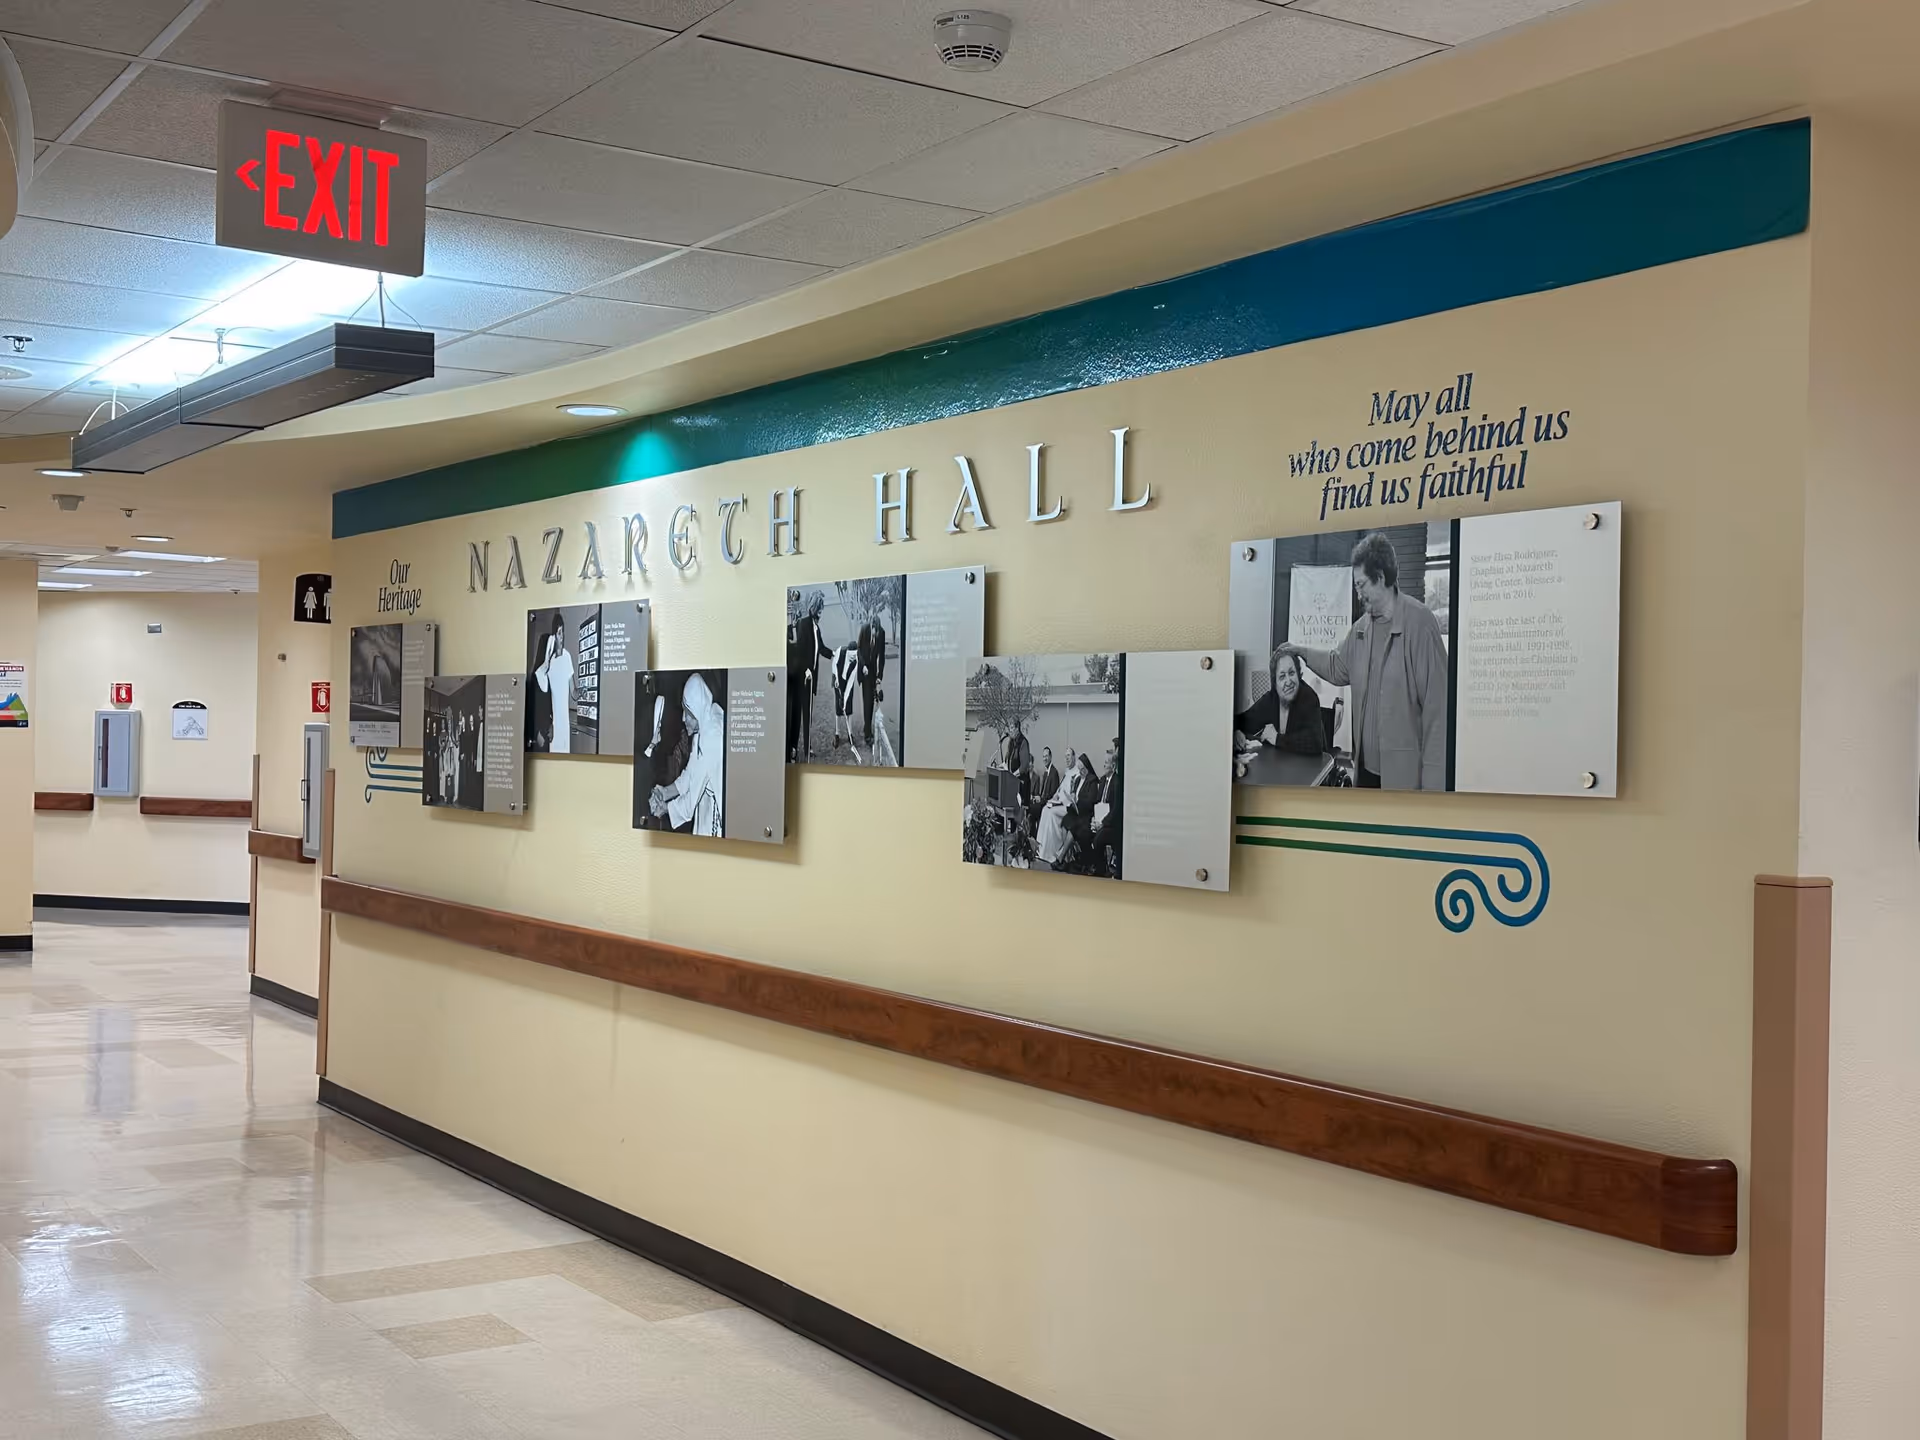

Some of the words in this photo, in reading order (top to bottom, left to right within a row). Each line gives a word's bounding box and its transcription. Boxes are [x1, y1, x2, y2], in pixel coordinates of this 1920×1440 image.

[264, 130, 399, 246] EXIT
[1368, 390, 1430, 428] May
[1435, 372, 1473, 416] all
[1288, 440, 1340, 478] who
[1346, 434, 1417, 470] come
[1424, 406, 1528, 459] behind
[1534, 410, 1570, 442] us
[1319, 472, 1375, 521] find
[1380, 475, 1411, 505] us
[1417, 450, 1529, 510] faithful
[466, 485, 806, 593] NAZARETH
[872, 426, 1153, 546] HALL
[390, 558, 411, 586] Our
[1516, 561, 1553, 573] Nazareth
[377, 585, 422, 616] Heritage
[1503, 592, 1511, 600] in
[1292, 615, 1348, 626] NAZARETH
[1303, 626, 1336, 639] LIVING
